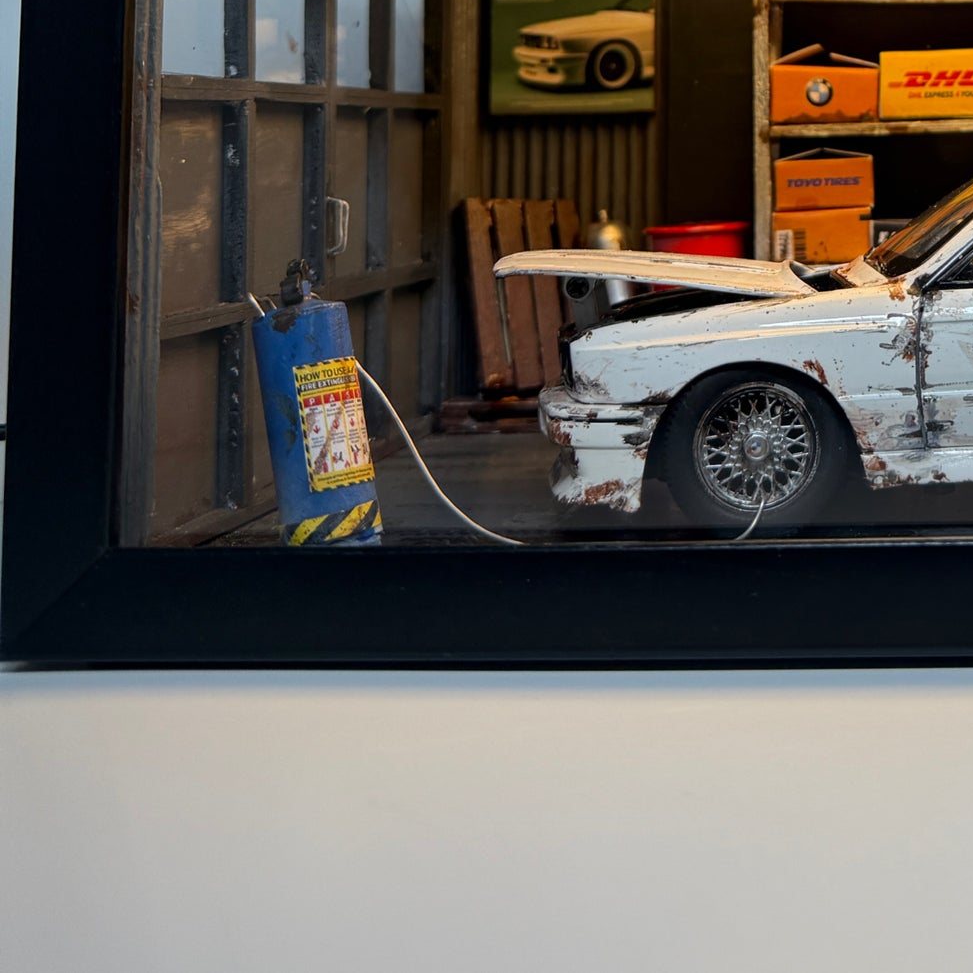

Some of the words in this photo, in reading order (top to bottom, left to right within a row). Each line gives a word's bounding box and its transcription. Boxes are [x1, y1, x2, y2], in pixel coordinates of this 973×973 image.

[787, 178, 822, 188] TOYO
[300, 371, 320, 382] HOW
[322, 369, 333, 378] TO
[334, 367, 347, 376] USE
[301, 383, 317, 391] FIRE
